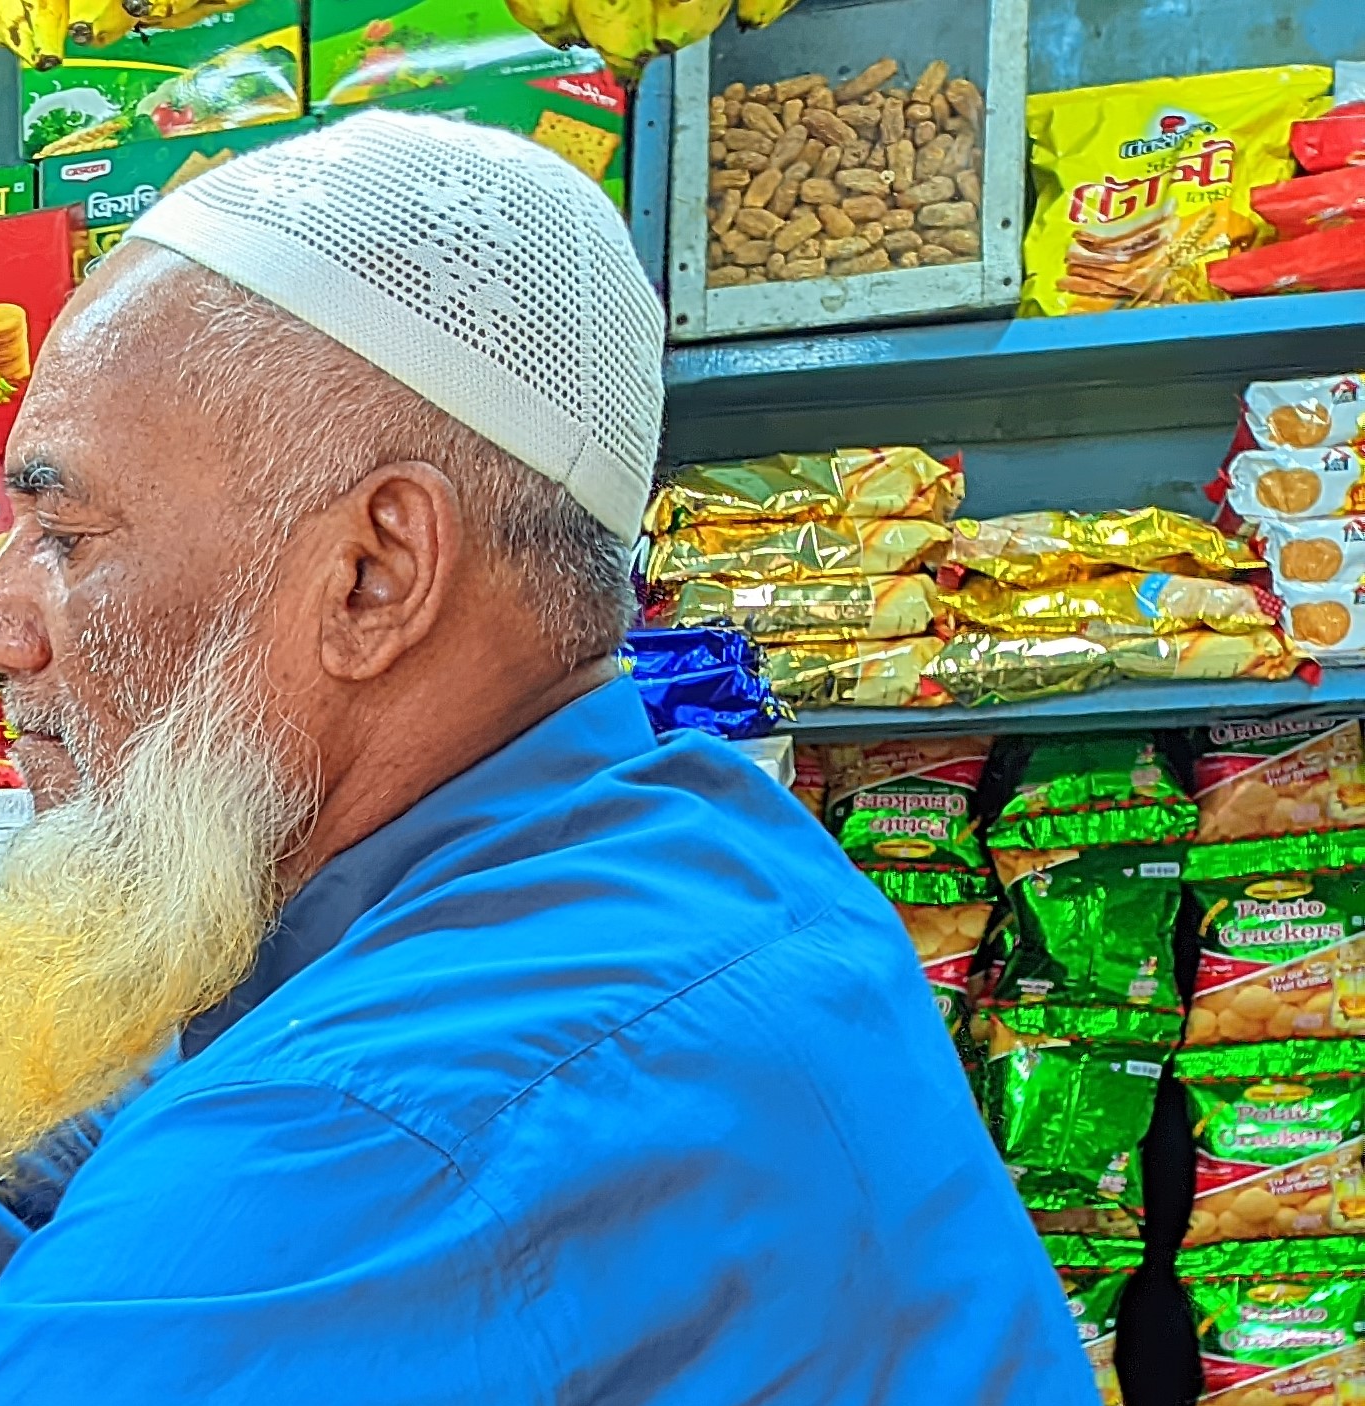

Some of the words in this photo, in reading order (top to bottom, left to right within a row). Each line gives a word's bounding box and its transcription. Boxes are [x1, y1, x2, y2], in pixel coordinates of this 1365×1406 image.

[853, 792, 968, 817] Crackers
[869, 816, 951, 840] Potato
[1233, 897, 1327, 920] Potato
[1218, 921, 1346, 949] Crackers
[1233, 1101, 1325, 1124] Potato
[1219, 1126, 1344, 1149] Crackers
